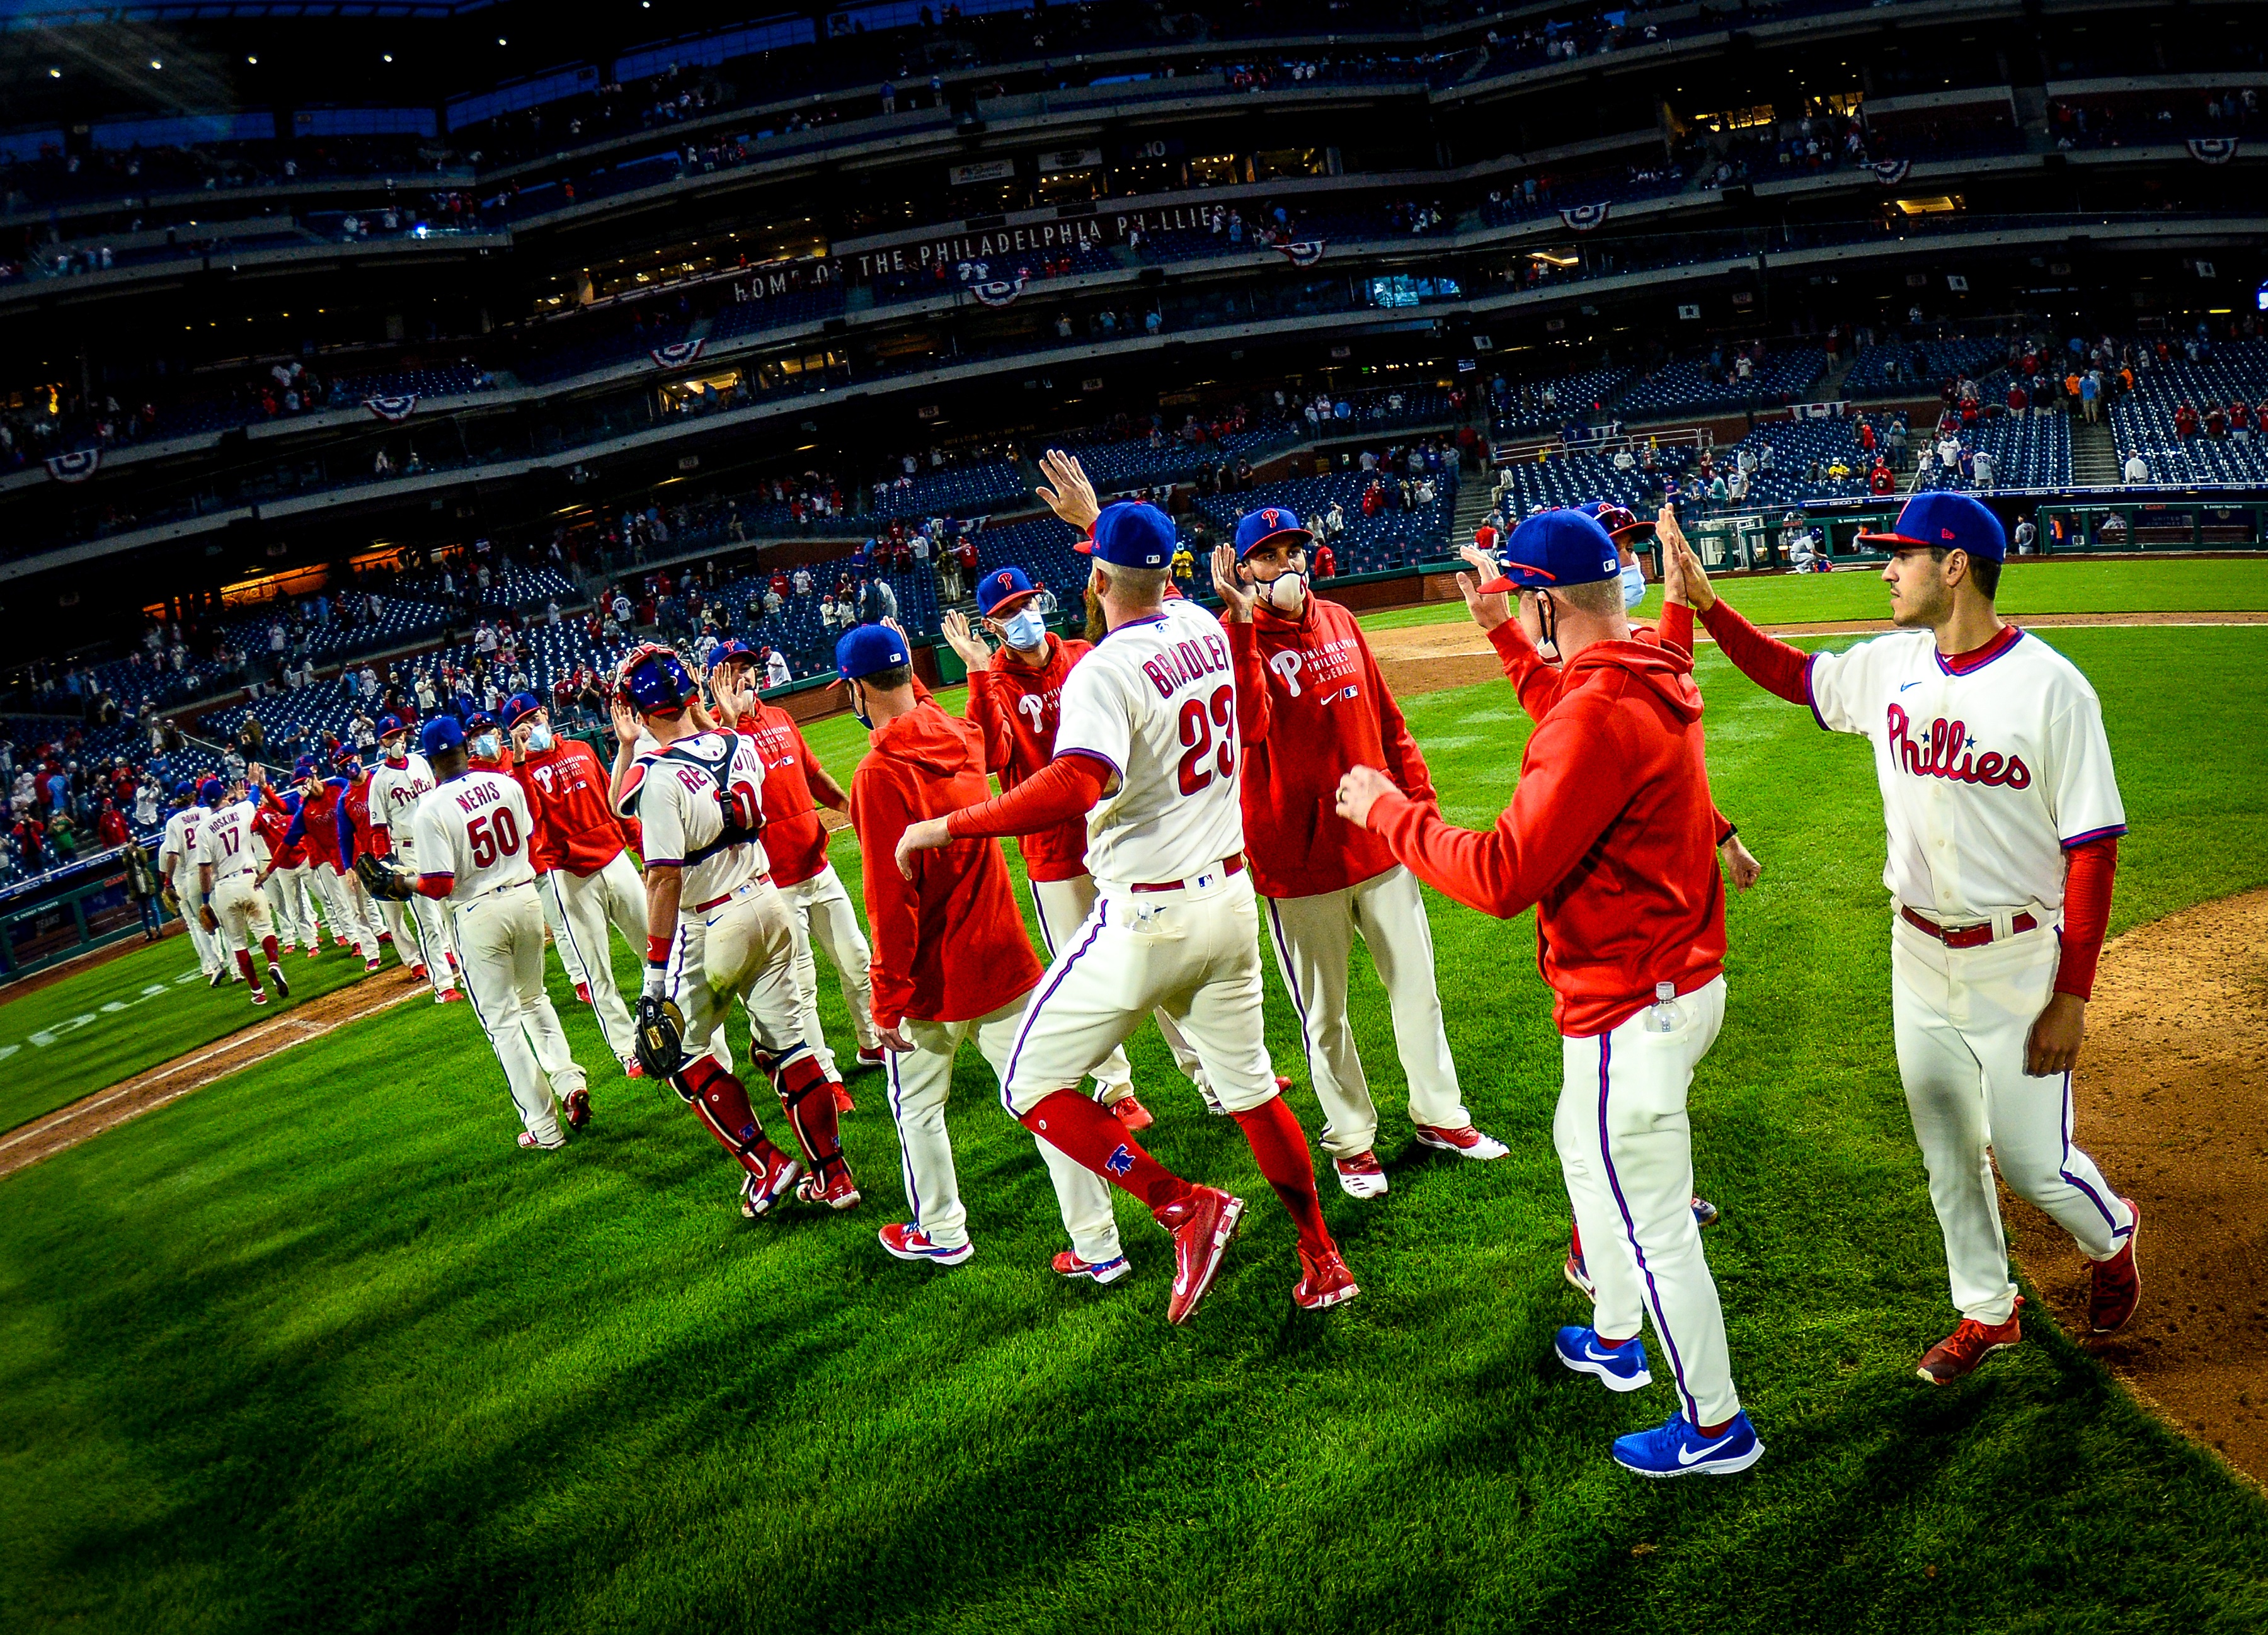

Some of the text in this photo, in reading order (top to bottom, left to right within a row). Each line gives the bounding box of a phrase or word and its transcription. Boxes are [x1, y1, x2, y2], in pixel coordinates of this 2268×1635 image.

[859, 250, 905, 276] THE
[919, 220, 1101, 266] PHILADELPHIA
[1261, 509, 1280, 528] P
[998, 573, 1012, 590] P
[1301, 638, 1358, 661] PHILADELPHIA
[1270, 650, 1302, 697] P
[511, 699, 521, 712] P
[1019, 694, 1043, 733] P
[1178, 684, 1235, 796] 23
[1887, 703, 2031, 790] Phillies
[533, 765, 553, 794] P
[455, 782, 500, 814] NERIS
[208, 811, 239, 834] HOSKINS
[467, 807, 520, 869] 50
[219, 826, 239, 856] 17
